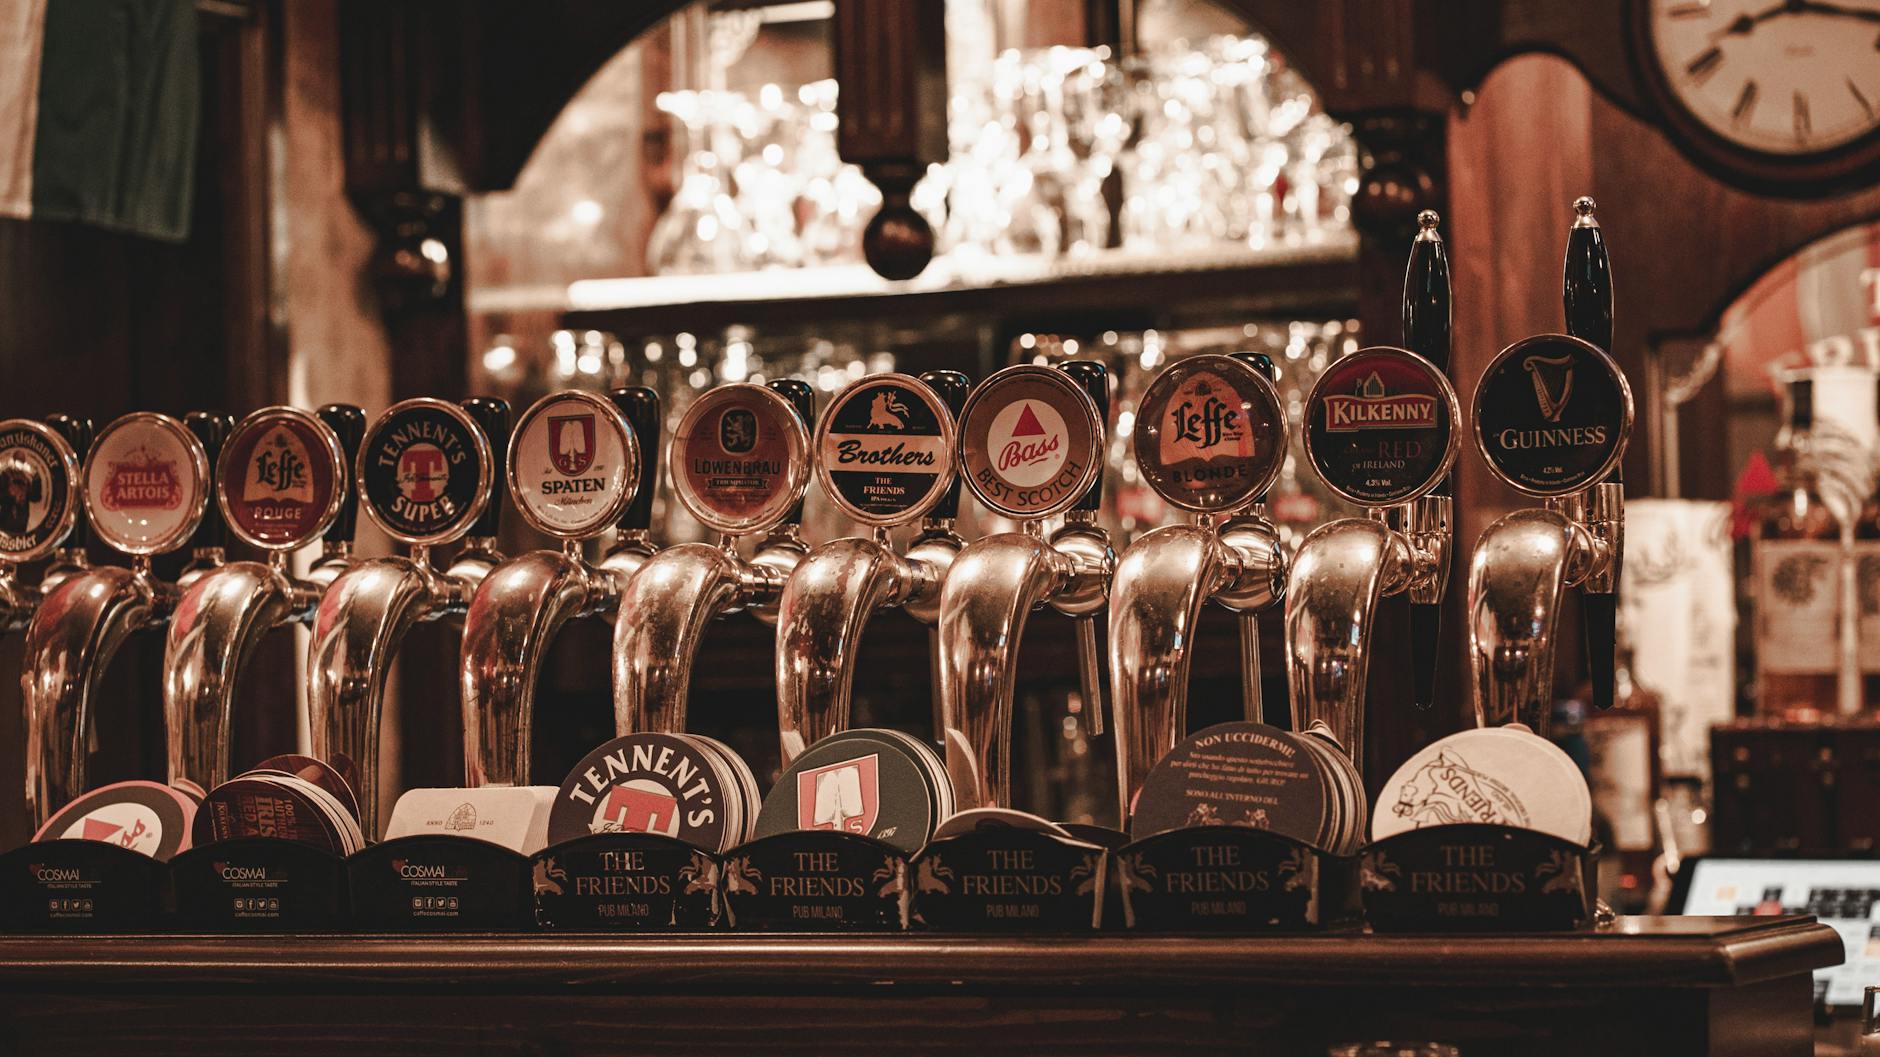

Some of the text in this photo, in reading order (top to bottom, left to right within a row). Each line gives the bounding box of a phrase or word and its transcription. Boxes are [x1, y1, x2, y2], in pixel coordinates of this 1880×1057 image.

[1171, 396, 1238, 449] Leffe
[1334, 401, 1431, 424] KILKENNY
[378, 421, 467, 466] TENNENT'S
[1500, 426, 1606, 449] GUINNESS
[837, 440, 935, 466] Brothers
[998, 434, 1059, 471] Bass
[1380, 441, 1422, 458] RED
[256, 449, 304, 491] Leffe
[1173, 464, 1247, 483] BLONDE
[1363, 460, 1405, 469] IRELAND
[118, 472, 169, 486] STELLA
[542, 478, 605, 495] SPATEN
[875, 477, 892, 485] THE
[977, 461, 1081, 507] BEST SCOTCH
[117, 486, 169, 500] ARTOIS
[863, 486, 905, 495] FRIENDS
[255, 507, 301, 519] ROUGE
[391, 496, 455, 522] SUPER
[1195, 732, 1297, 758] NON UCCIDERMI!
[569, 744, 714, 828] TENNENT'S
[1440, 767, 1497, 824] RIENDS
[255, 796, 277, 837] IRIS
[275, 799, 289, 839] AUTHEN
[599, 851, 645, 870] THE
[794, 852, 839, 871] THE
[987, 850, 1034, 870] THE
[1192, 846, 1240, 867] THE
[1440, 845, 1494, 866] THE
[37, 868, 79, 880] COSMAI
[223, 867, 265, 879] COSMAI
[400, 865, 445, 877] COSMAI
[576, 876, 670, 895] FRIENDS
[770, 876, 865, 896] FRIENDS
[962, 875, 1062, 895] FRIENDS
[1166, 870, 1269, 893] FRIENDS
[1411, 871, 1525, 893] FRIENDS
[599, 903, 648, 917] PUB MILANO
[793, 905, 843, 918] PUB MILANO
